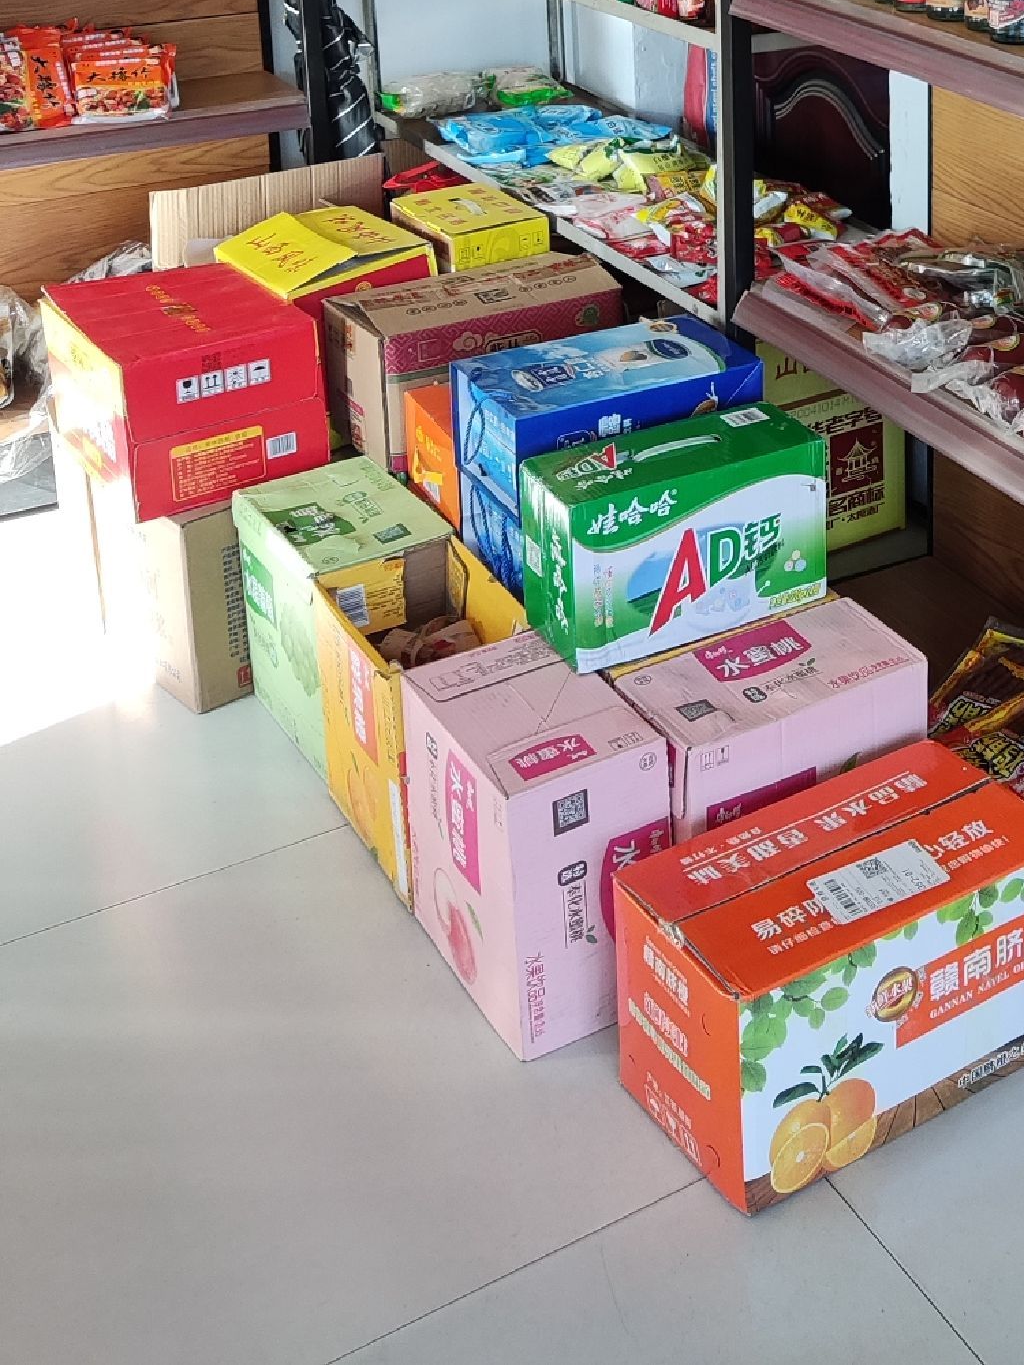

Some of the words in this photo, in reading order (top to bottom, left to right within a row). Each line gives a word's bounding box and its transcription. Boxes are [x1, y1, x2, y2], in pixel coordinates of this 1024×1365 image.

[586, 488, 671, 535] 娃哈哈
[716, 635, 805, 678] 水蜜桃
[929, 989, 974, 1020] GANNAN
